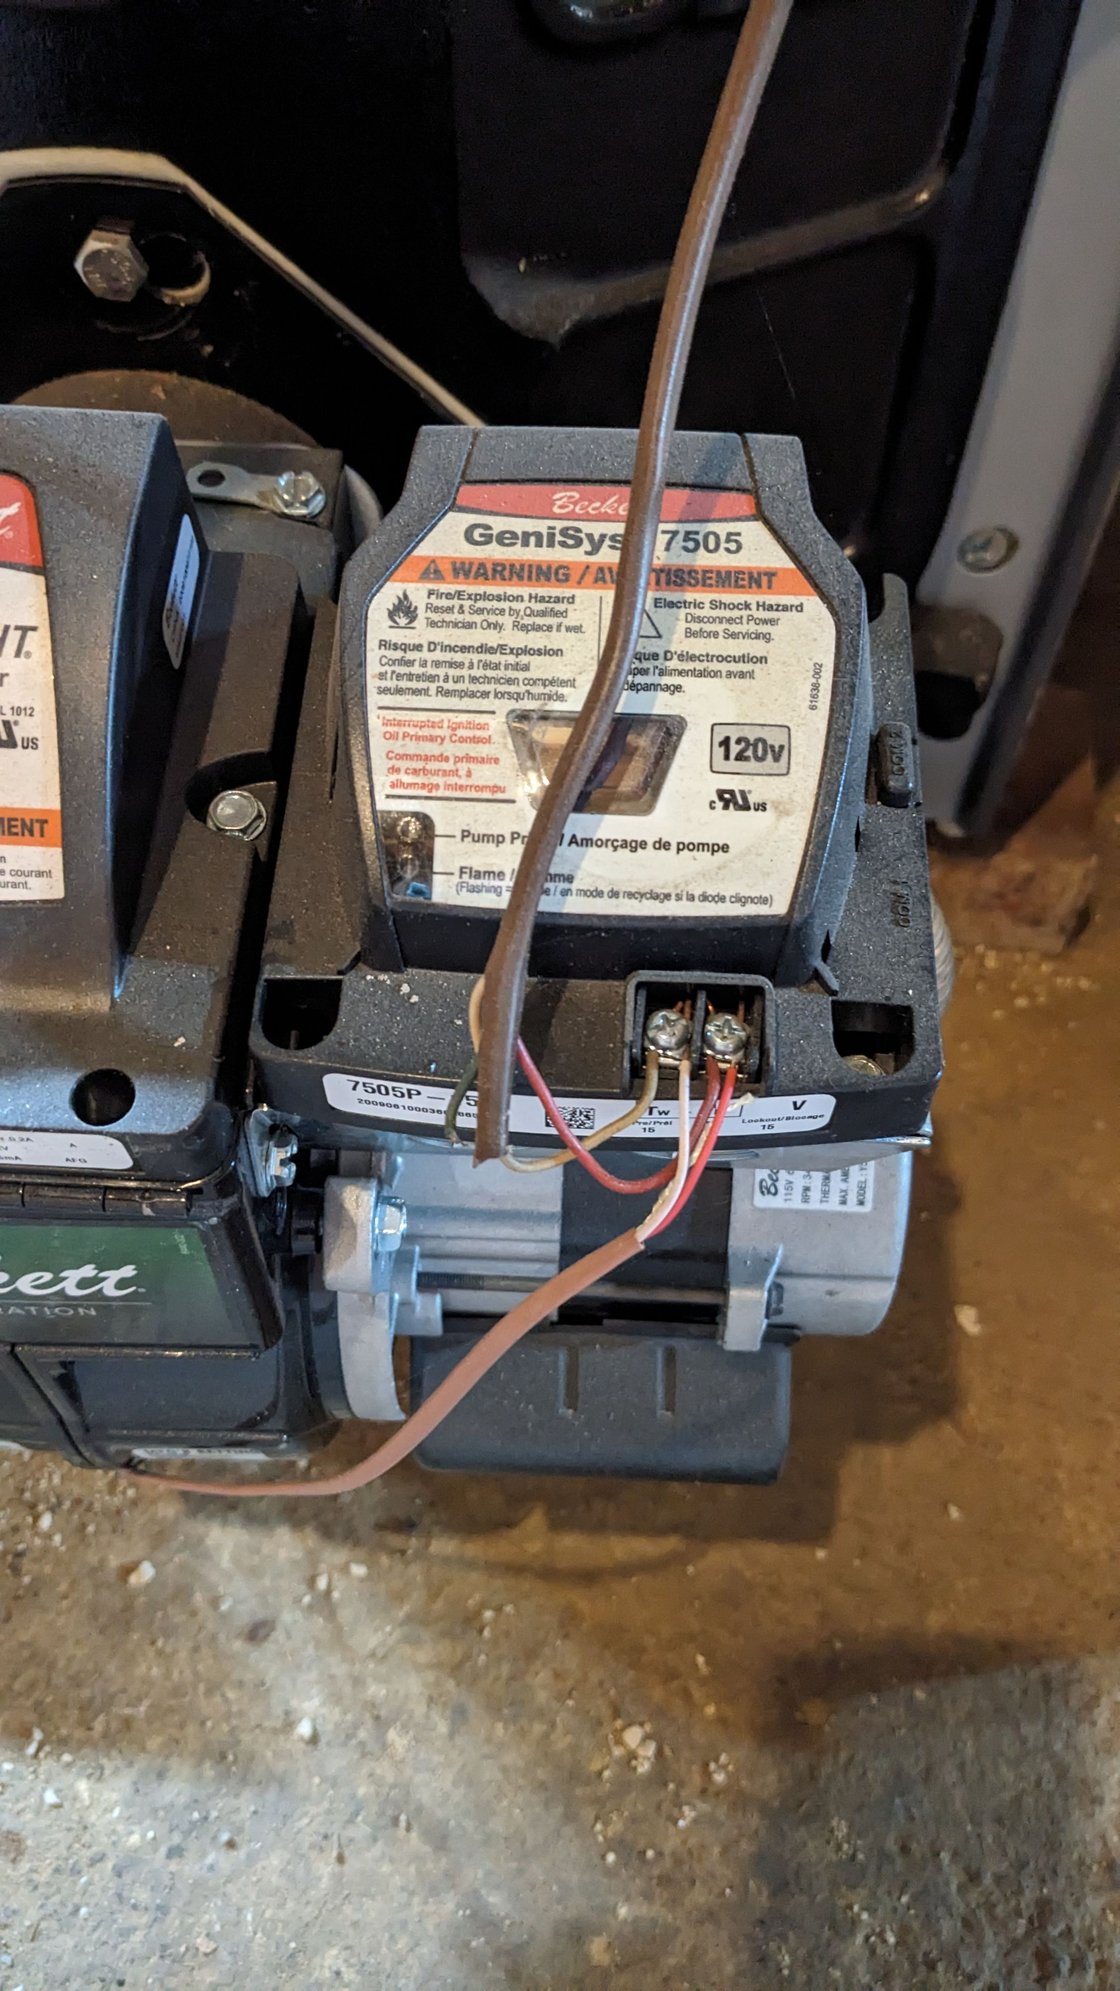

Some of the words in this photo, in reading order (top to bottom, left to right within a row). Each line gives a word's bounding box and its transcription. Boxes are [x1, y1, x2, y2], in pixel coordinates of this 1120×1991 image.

[552, 491, 630, 515] Becke
[660, 530, 743, 554] 7505
[450, 561, 570, 583] WARNING
[592, 565, 778, 590] AVTISSEMENT
[427, 589, 524, 606] Fire/Explosion
[528, 591, 576, 605] Hazard
[653, 597, 706, 610] Electric
[708, 599, 752, 612] Shock
[755, 601, 804, 613] Hazard
[424, 603, 455, 615] Reset
[457, 604, 465, 615] &
[468, 605, 506, 617] Service
[523, 607, 568, 619] Qualified
[424, 617, 477, 630] Technician
[480, 619, 506, 634] Only.
[512, 620, 553, 634] Replace
[555, 620, 562, 633] if
[684, 612, 743, 625] Disconnect
[746, 614, 781, 627] Power
[684, 627, 720, 639] Before
[722, 629, 775, 644] Servicing.
[378, 640, 424, 654] Risque
[379, 656, 417, 668] Confier
[418, 657, 428, 669] la
[430, 660, 465, 670] remise
[504, 660, 530, 672] initial
[633, 651, 659, 664] que
[663, 650, 768, 665] D'électrocution
[378, 672, 388, 682] et
[390, 671, 441, 684] l'entretien
[453, 675, 466, 684] un
[468, 674, 520, 687] technicien
[522, 676, 576, 690] compétent
[652, 665, 722, 680] l'alimentation
[725, 668, 756, 680] avant
[376, 685, 431, 697] seulement.
[435, 687, 491, 702] Remplacer
[808, 662, 824, 711] 61638-002
[10, 706, 35, 717] 1012
[382, 716, 444, 730] Interrupted
[447, 719, 490, 731] Ignition
[21, 736, 39, 750] US
[383, 731, 399, 742] Oil
[402, 731, 446, 744] Primary
[450, 733, 492, 745] Control
[385, 750, 450, 764] Commande
[453, 753, 500, 765] primaire
[387, 765, 401, 775] de
[389, 779, 440, 793] allumage
[443, 781, 506, 795] interrompu
[460, 830, 506, 847] Pump
[568, 834, 648, 853] Amorçage
[652, 837, 672, 851] de
[676, 841, 730, 856] pompe
[10, 867, 52, 879] courant
[459, 866, 506, 880] Flame
[456, 882, 503, 896] (Flashing
[560, 887, 573, 897] en
[575, 887, 605, 898] mode
[607, 888, 621, 899] de
[622, 889, 672, 902] recyclage
[674, 890, 684, 901] si
[686, 891, 695, 902] la
[698, 892, 727, 903] diode
[729, 893, 773, 907] clignote)
[347, 1079, 422, 1100] 7505P
[792, 1100, 807, 1111] V
[784, 1179, 794, 1202] 115V
